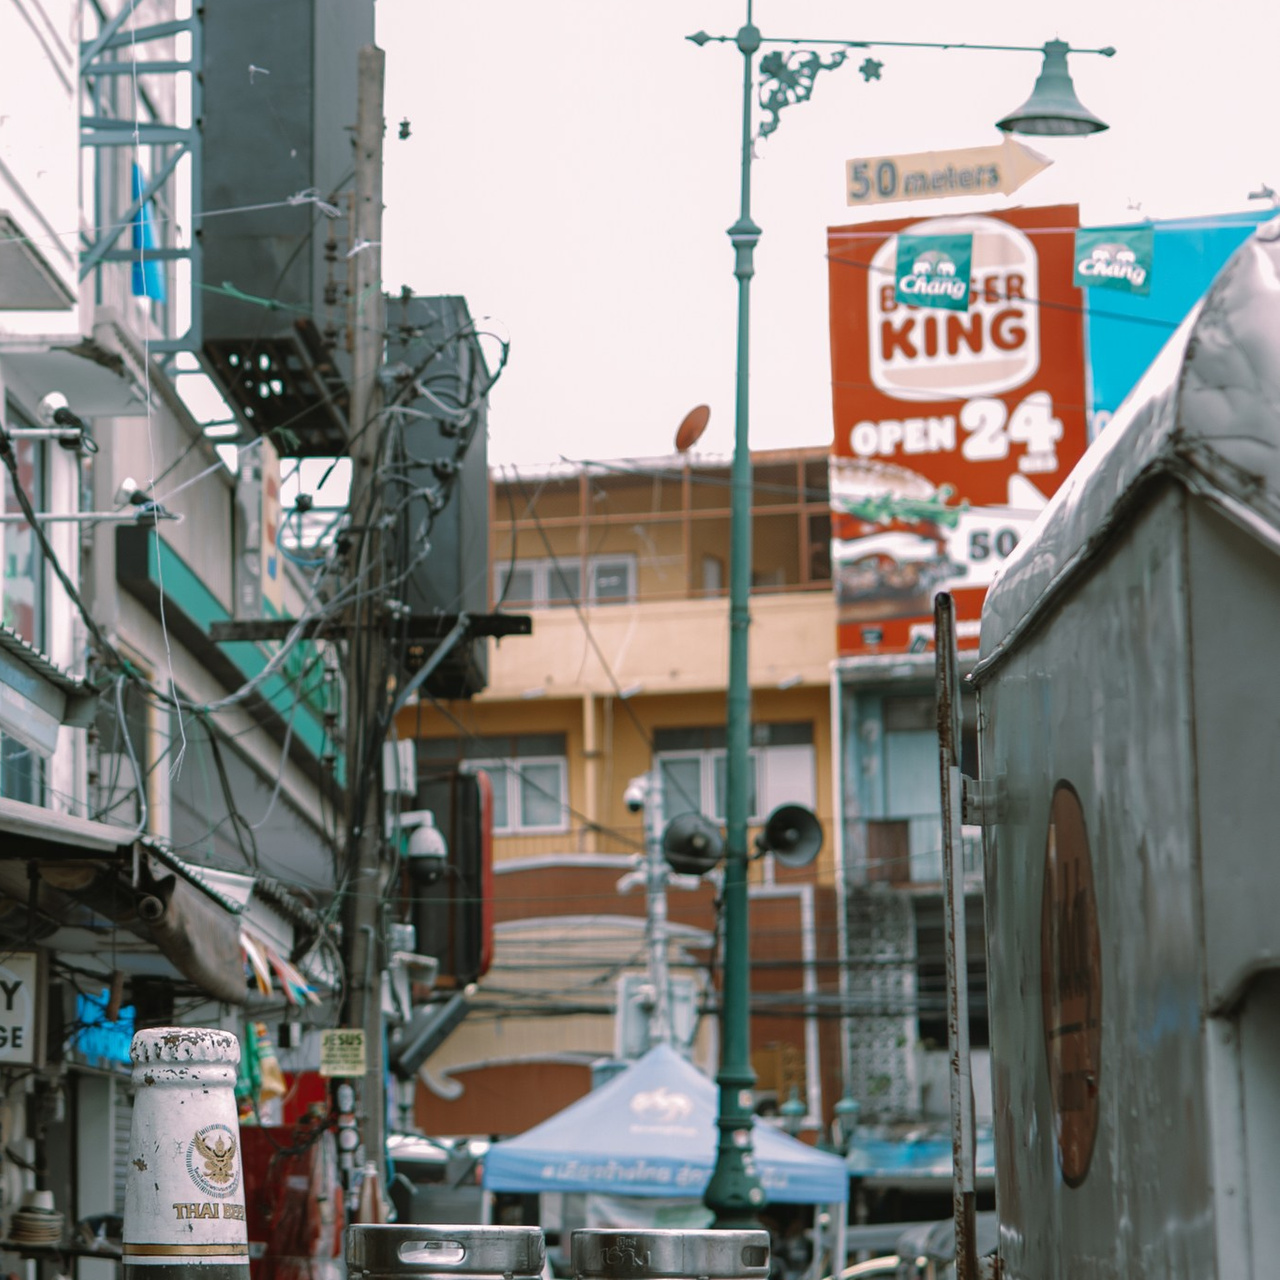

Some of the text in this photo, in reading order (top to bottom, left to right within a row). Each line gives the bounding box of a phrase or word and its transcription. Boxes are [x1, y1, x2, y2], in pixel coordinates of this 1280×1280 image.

[851, 160, 1000, 200] 50 meters
[899, 274, 966, 300] Chang
[1077, 258, 1147, 287] Chang
[881, 309, 1027, 361] KING
[850, 415, 957, 457] OPEN
[960, 391, 1063, 461] 24
[969, 528, 1020, 563] 50
[172, 1202, 220, 1220] THAI
